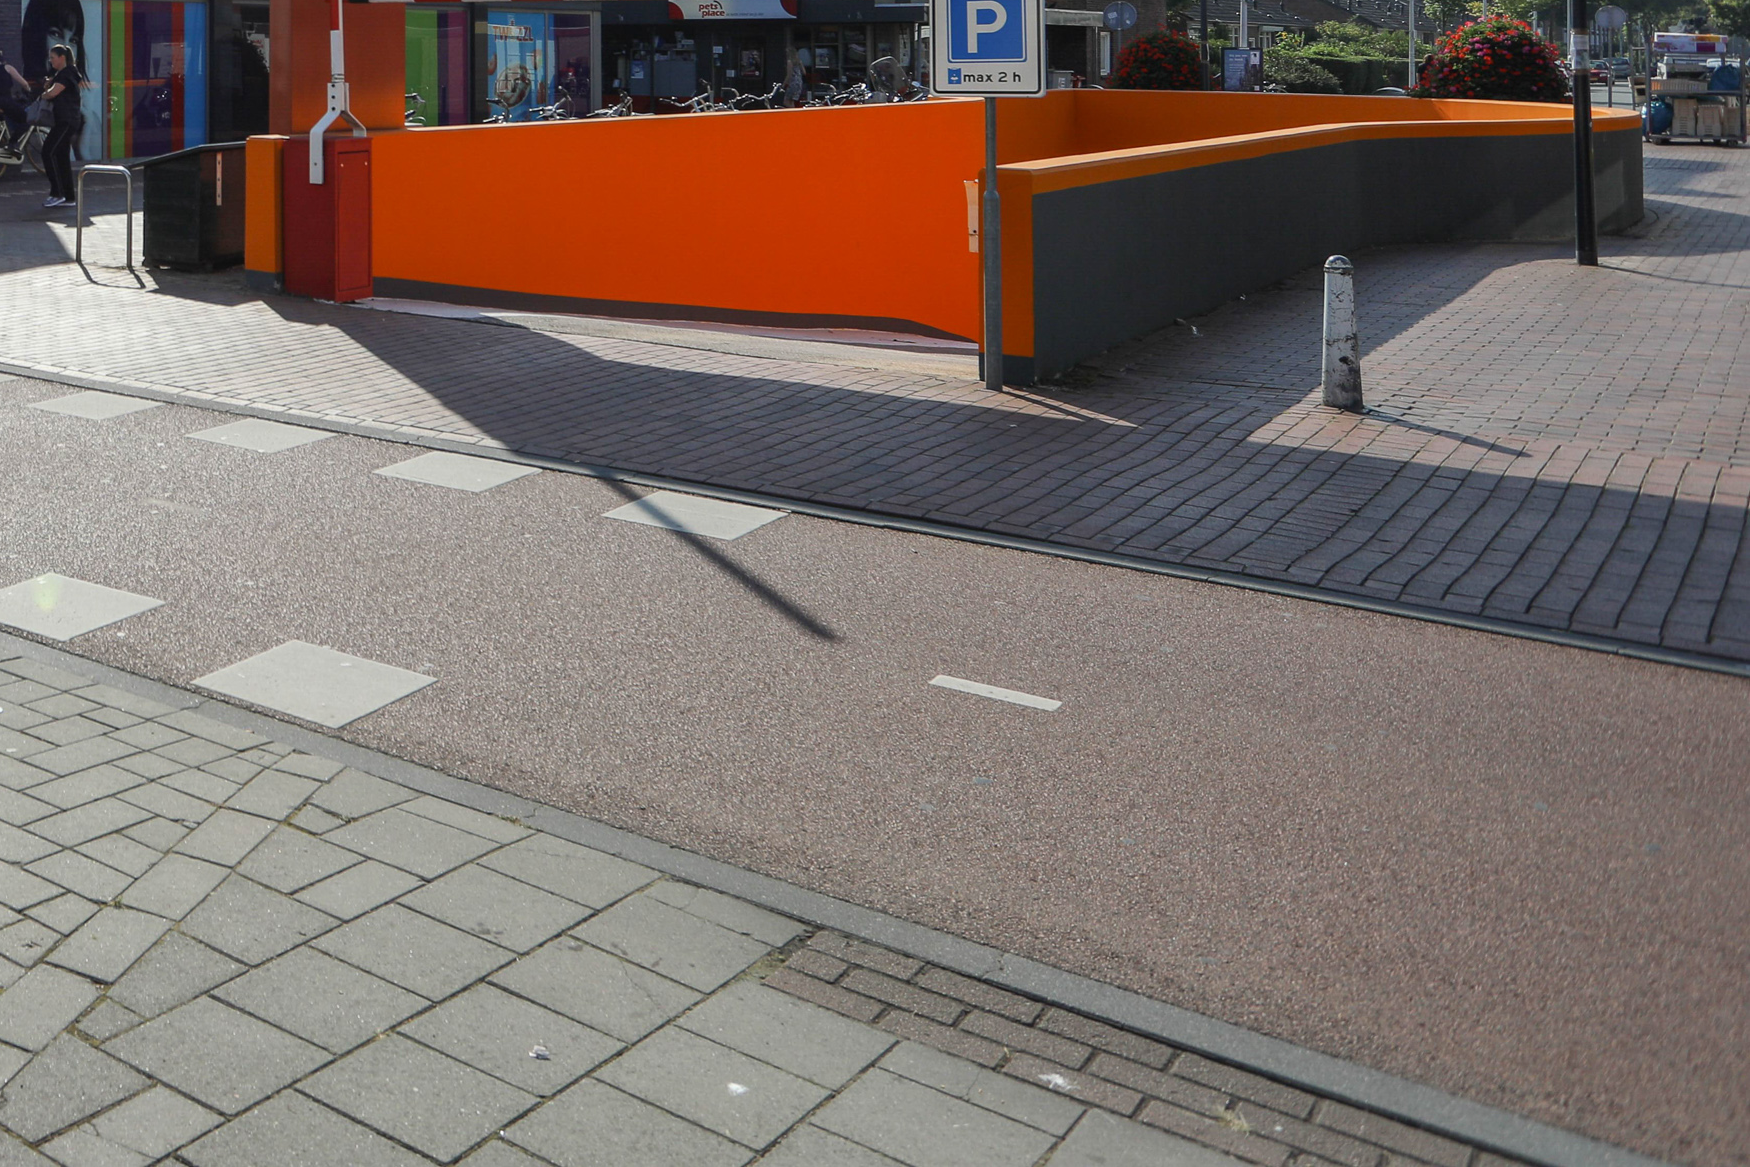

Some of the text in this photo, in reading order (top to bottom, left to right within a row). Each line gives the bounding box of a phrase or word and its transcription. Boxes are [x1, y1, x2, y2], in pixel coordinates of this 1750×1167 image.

[698, 2, 719, 12] pets
[701, 9, 726, 18] place
[492, 21, 534, 42] TWZZL
[966, 0, 1008, 54] P
[962, 71, 1022, 83] max 2 h
